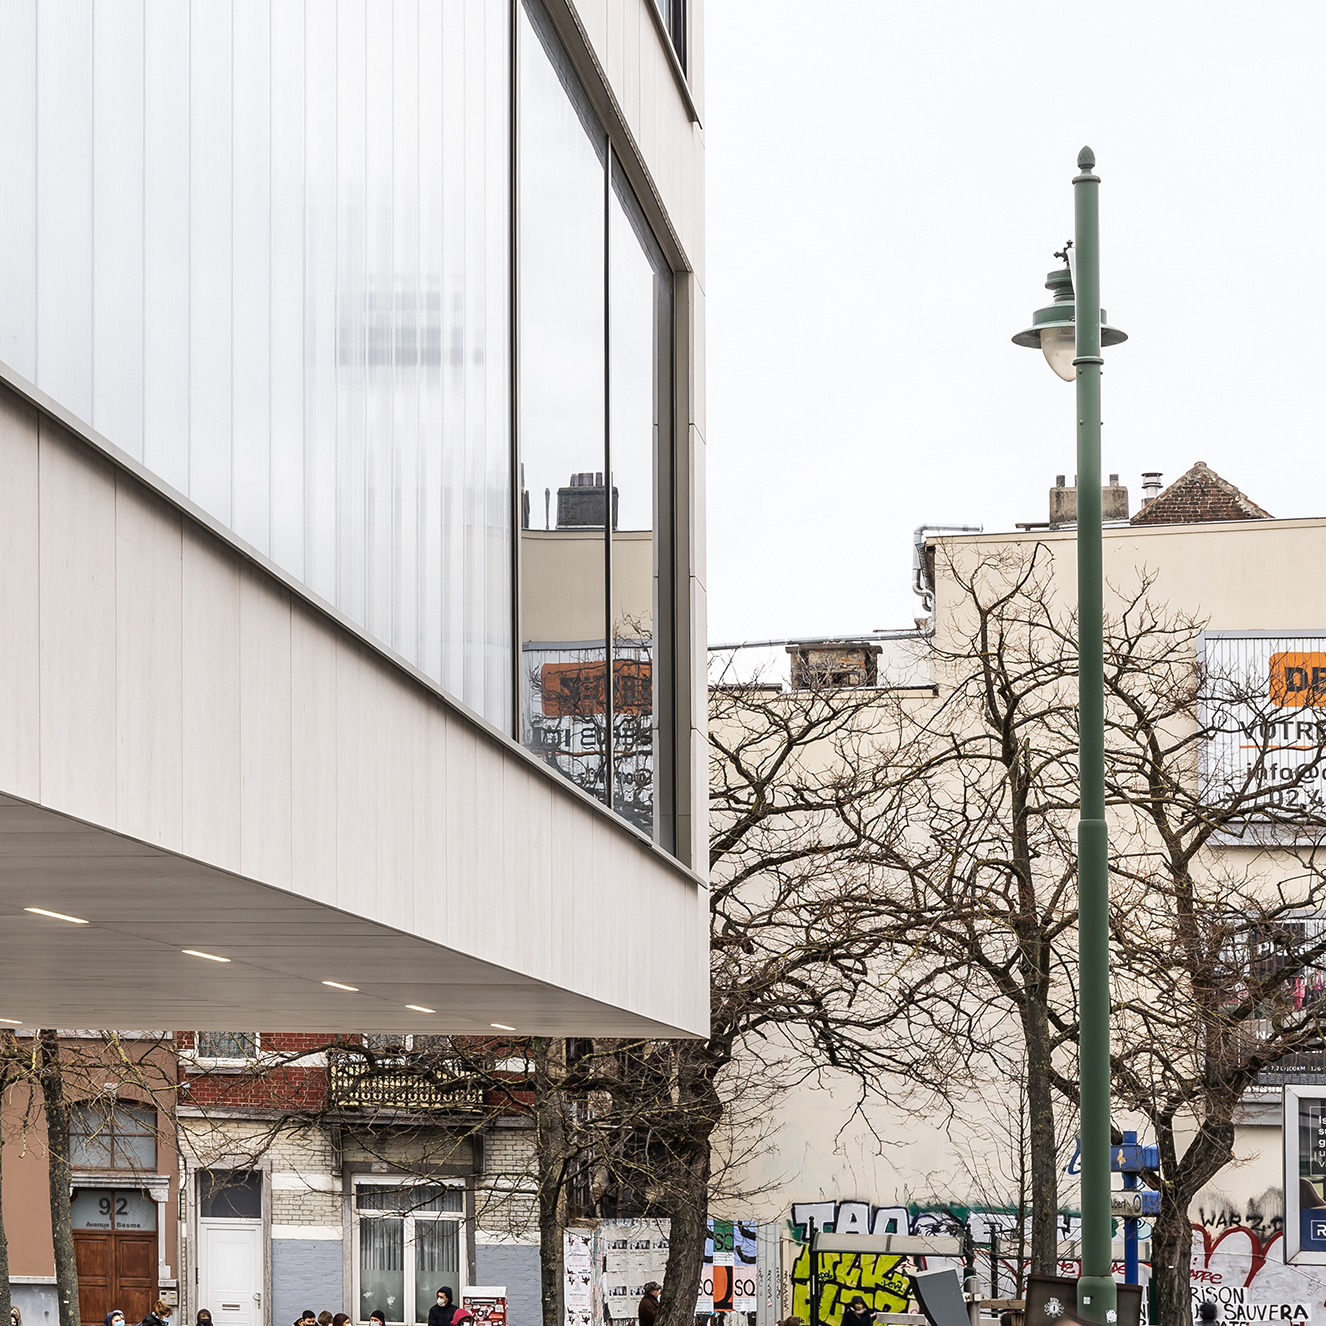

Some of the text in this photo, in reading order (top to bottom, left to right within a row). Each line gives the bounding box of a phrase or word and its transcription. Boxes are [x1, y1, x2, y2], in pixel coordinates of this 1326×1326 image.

[99, 1197, 128, 1216] 92
[86, 1221, 141, 1230] Avenue Besme
[734, 1278, 755, 1297] SQ
[1224, 1303, 1309, 1321] SAUVERA
